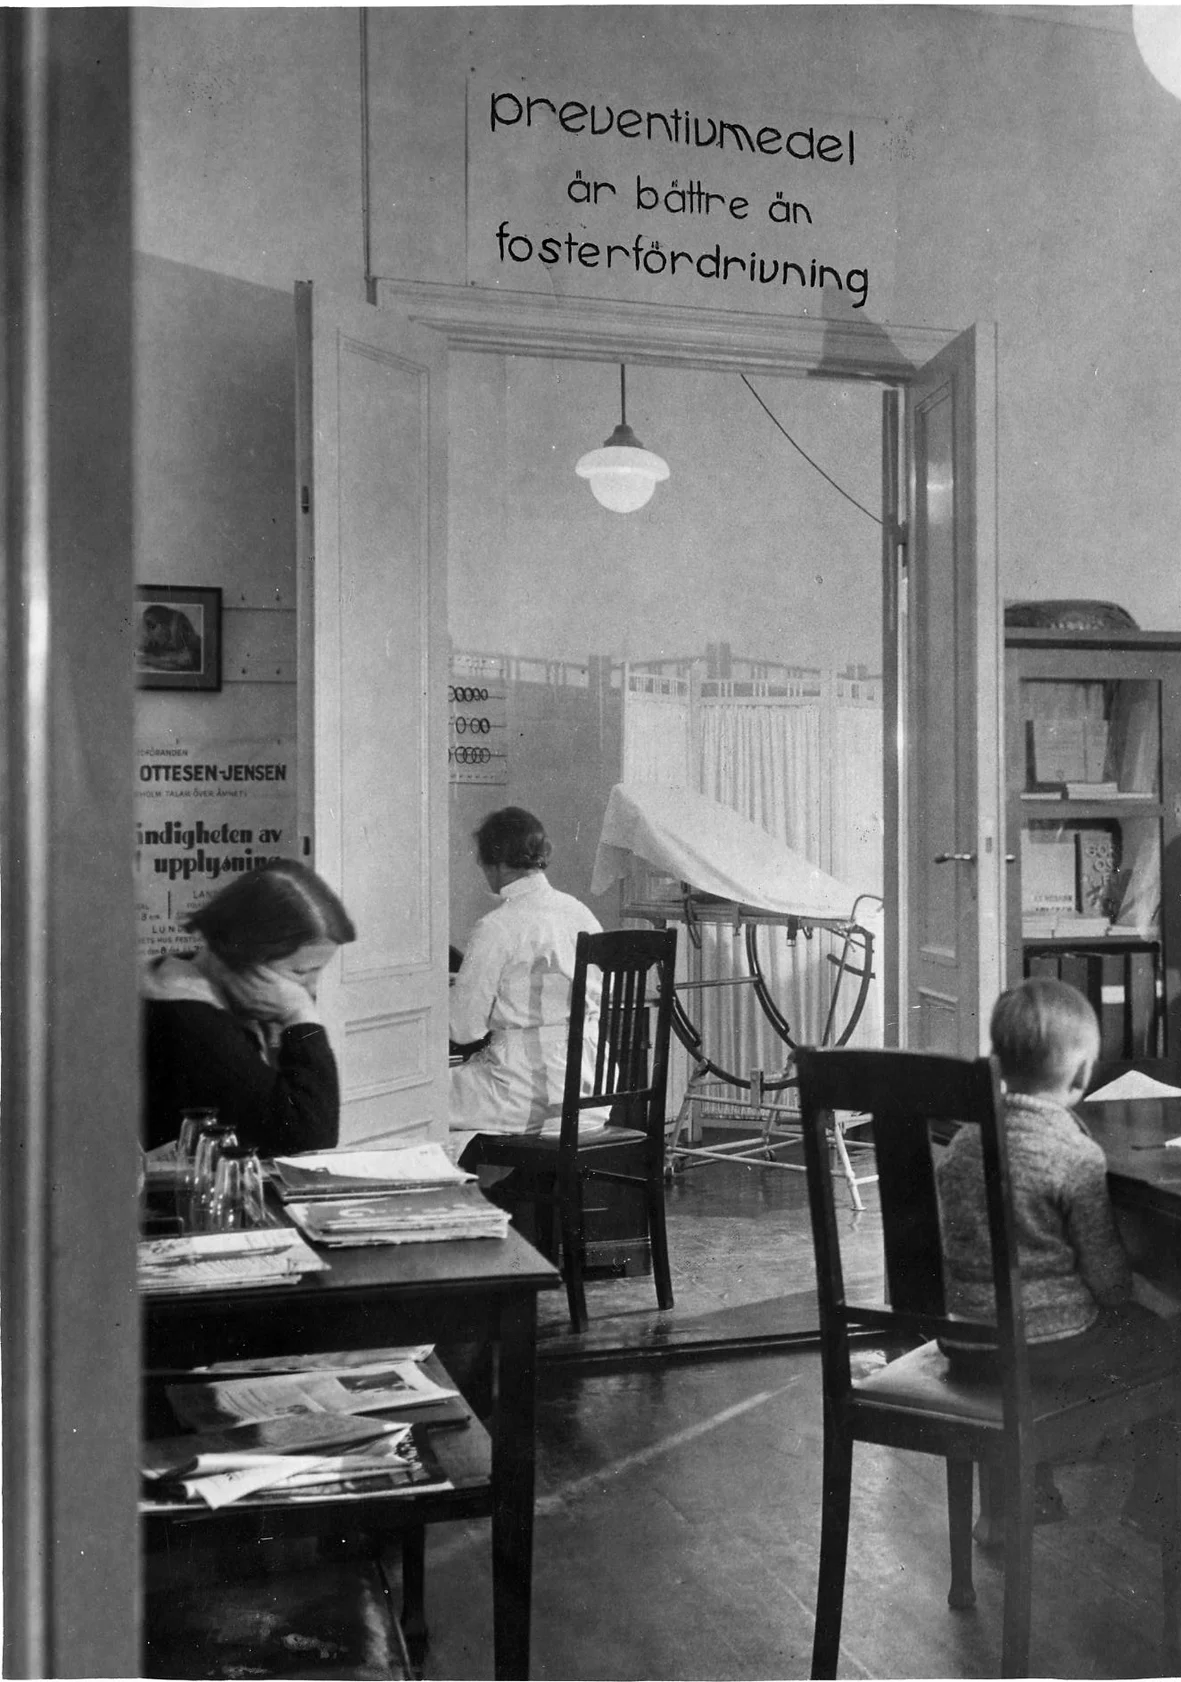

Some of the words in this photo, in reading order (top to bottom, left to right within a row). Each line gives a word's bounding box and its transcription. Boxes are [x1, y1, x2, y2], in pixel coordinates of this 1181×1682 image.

[490, 92, 855, 166] preventivmedel
[567, 170, 616, 204] är
[636, 174, 749, 220] bättre
[768, 191, 813, 224] än
[495, 221, 869, 309] fosterfördrivning
[140, 764, 287, 782] OTTESEN-JENSEN
[258, 828, 282, 844] av
[154, 848, 281, 880] upplysnin
